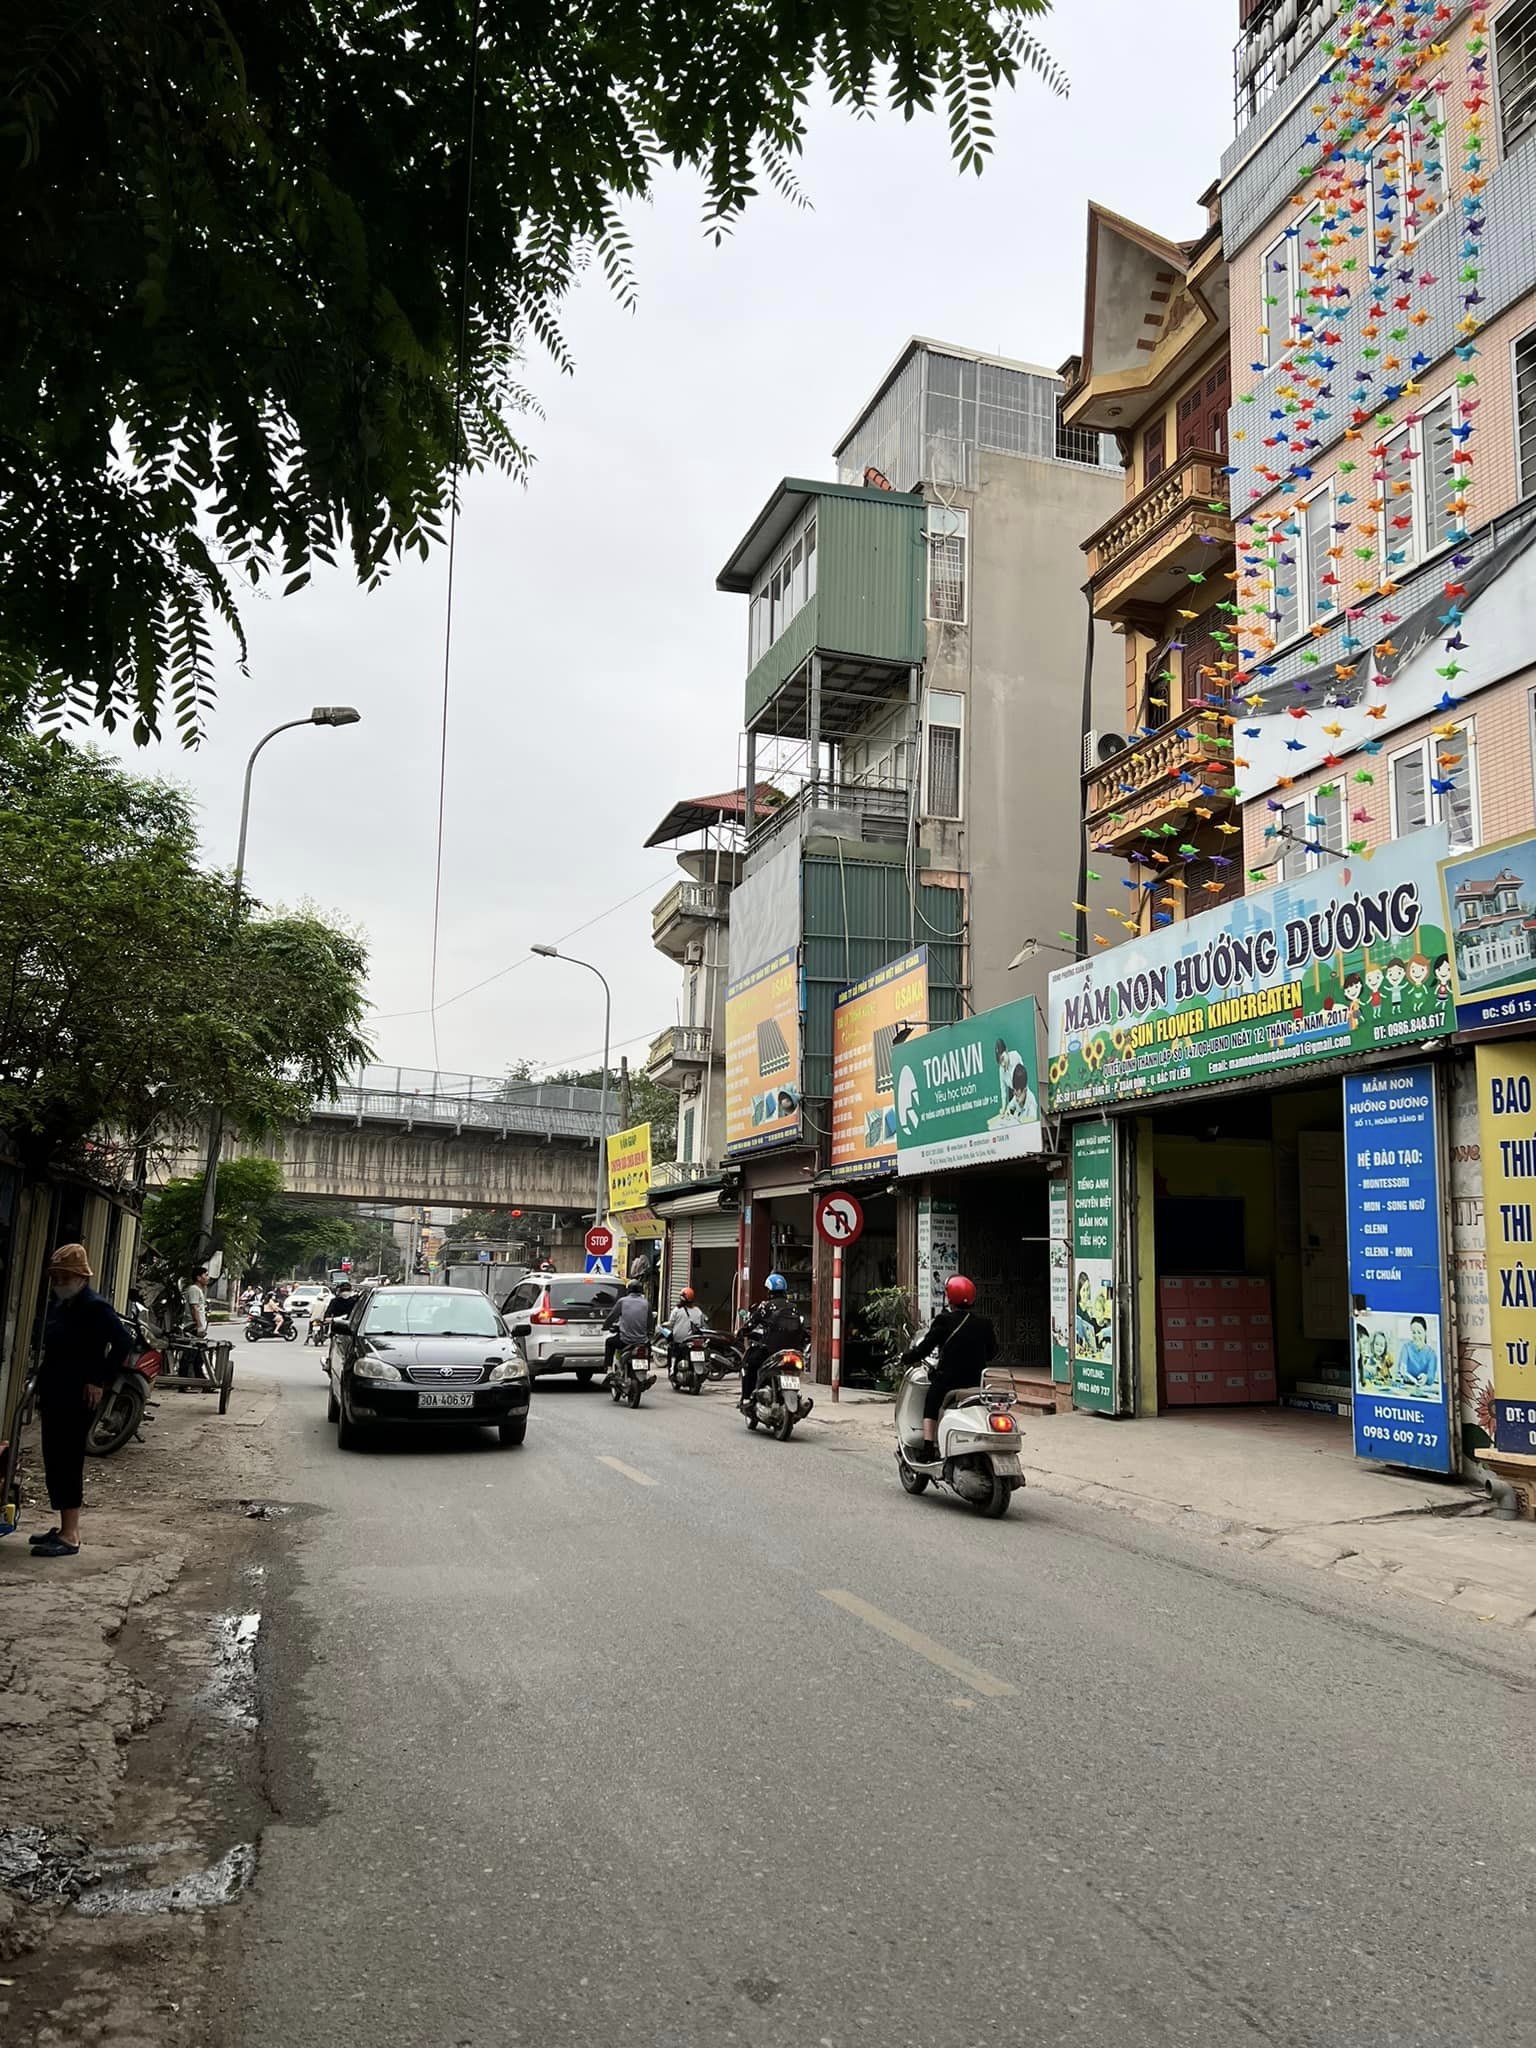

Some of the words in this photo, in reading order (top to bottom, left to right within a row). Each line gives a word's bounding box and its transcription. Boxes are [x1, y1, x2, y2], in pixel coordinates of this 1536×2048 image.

[1064, 974, 1112, 1034] MẦM
[1116, 965, 1169, 1018] NON
[1174, 932, 1278, 1001] HƯỚNG
[1285, 882, 1421, 968] DƯƠNG
[895, 980, 923, 1010] OSAKA
[1130, 1022, 1153, 1049] SUN
[1157, 1009, 1205, 1041] FLOWER
[1208, 981, 1303, 1030] KINDERGATEN
[1501, 1000, 1516, 1015] SỐ
[1519, 1000, 1532, 1013] 15
[1254, 1028, 1264, 1043] 12
[1265, 1018, 1293, 1041] THÁNG
[1294, 1019, 1302, 1034] 5
[1303, 1011, 1325, 1032] NĂM
[1326, 1007, 1349, 1027] 2017
[1387, 1012, 1446, 1038] 0986.848.617
[922, 1041, 984, 1089] TOAN.VN
[934, 1090, 946, 1104] Yêu
[947, 1088, 960, 1101] học
[960, 1081, 976, 1097] toán
[1390, 1077, 1414, 1090] NON
[1491, 1074, 1532, 1115] BAO
[1350, 1099, 1387, 1114] HƯỚNG
[1389, 1096, 1429, 1110] DƯƠNG
[1357, 1149, 1371, 1170] HỆ
[1373, 1148, 1396, 1166] ĐÀO
[1397, 1149, 1423, 1168] TẠO:
[1095, 1178, 1109, 1190] ANH
[1362, 1178, 1410, 1190] MONTESSORI
[1100, 1194, 1112, 1210] BIỆT
[1363, 1201, 1380, 1212] MON
[1386, 1200, 1408, 1211] SONG
[1408, 1197, 1426, 1211] NGỮ
[1094, 1216, 1108, 1227] NON
[1364, 1224, 1388, 1234] GLENN
[1500, 1203, 1533, 1243] THI
[590, 1235, 608, 1246] STOP
[1092, 1235, 1107, 1248] HỌC
[1364, 1246, 1389, 1257] GLENN
[1394, 1247, 1413, 1257] MON
[1366, 1270, 1375, 1280] CT
[1506, 1338, 1530, 1366] TỪ
[1374, 1405, 1425, 1424] HOTLINE:
[1362, 1426, 1390, 1440] 0983
[1392, 1432, 1414, 1444] 609
[1416, 1432, 1438, 1448] 737
